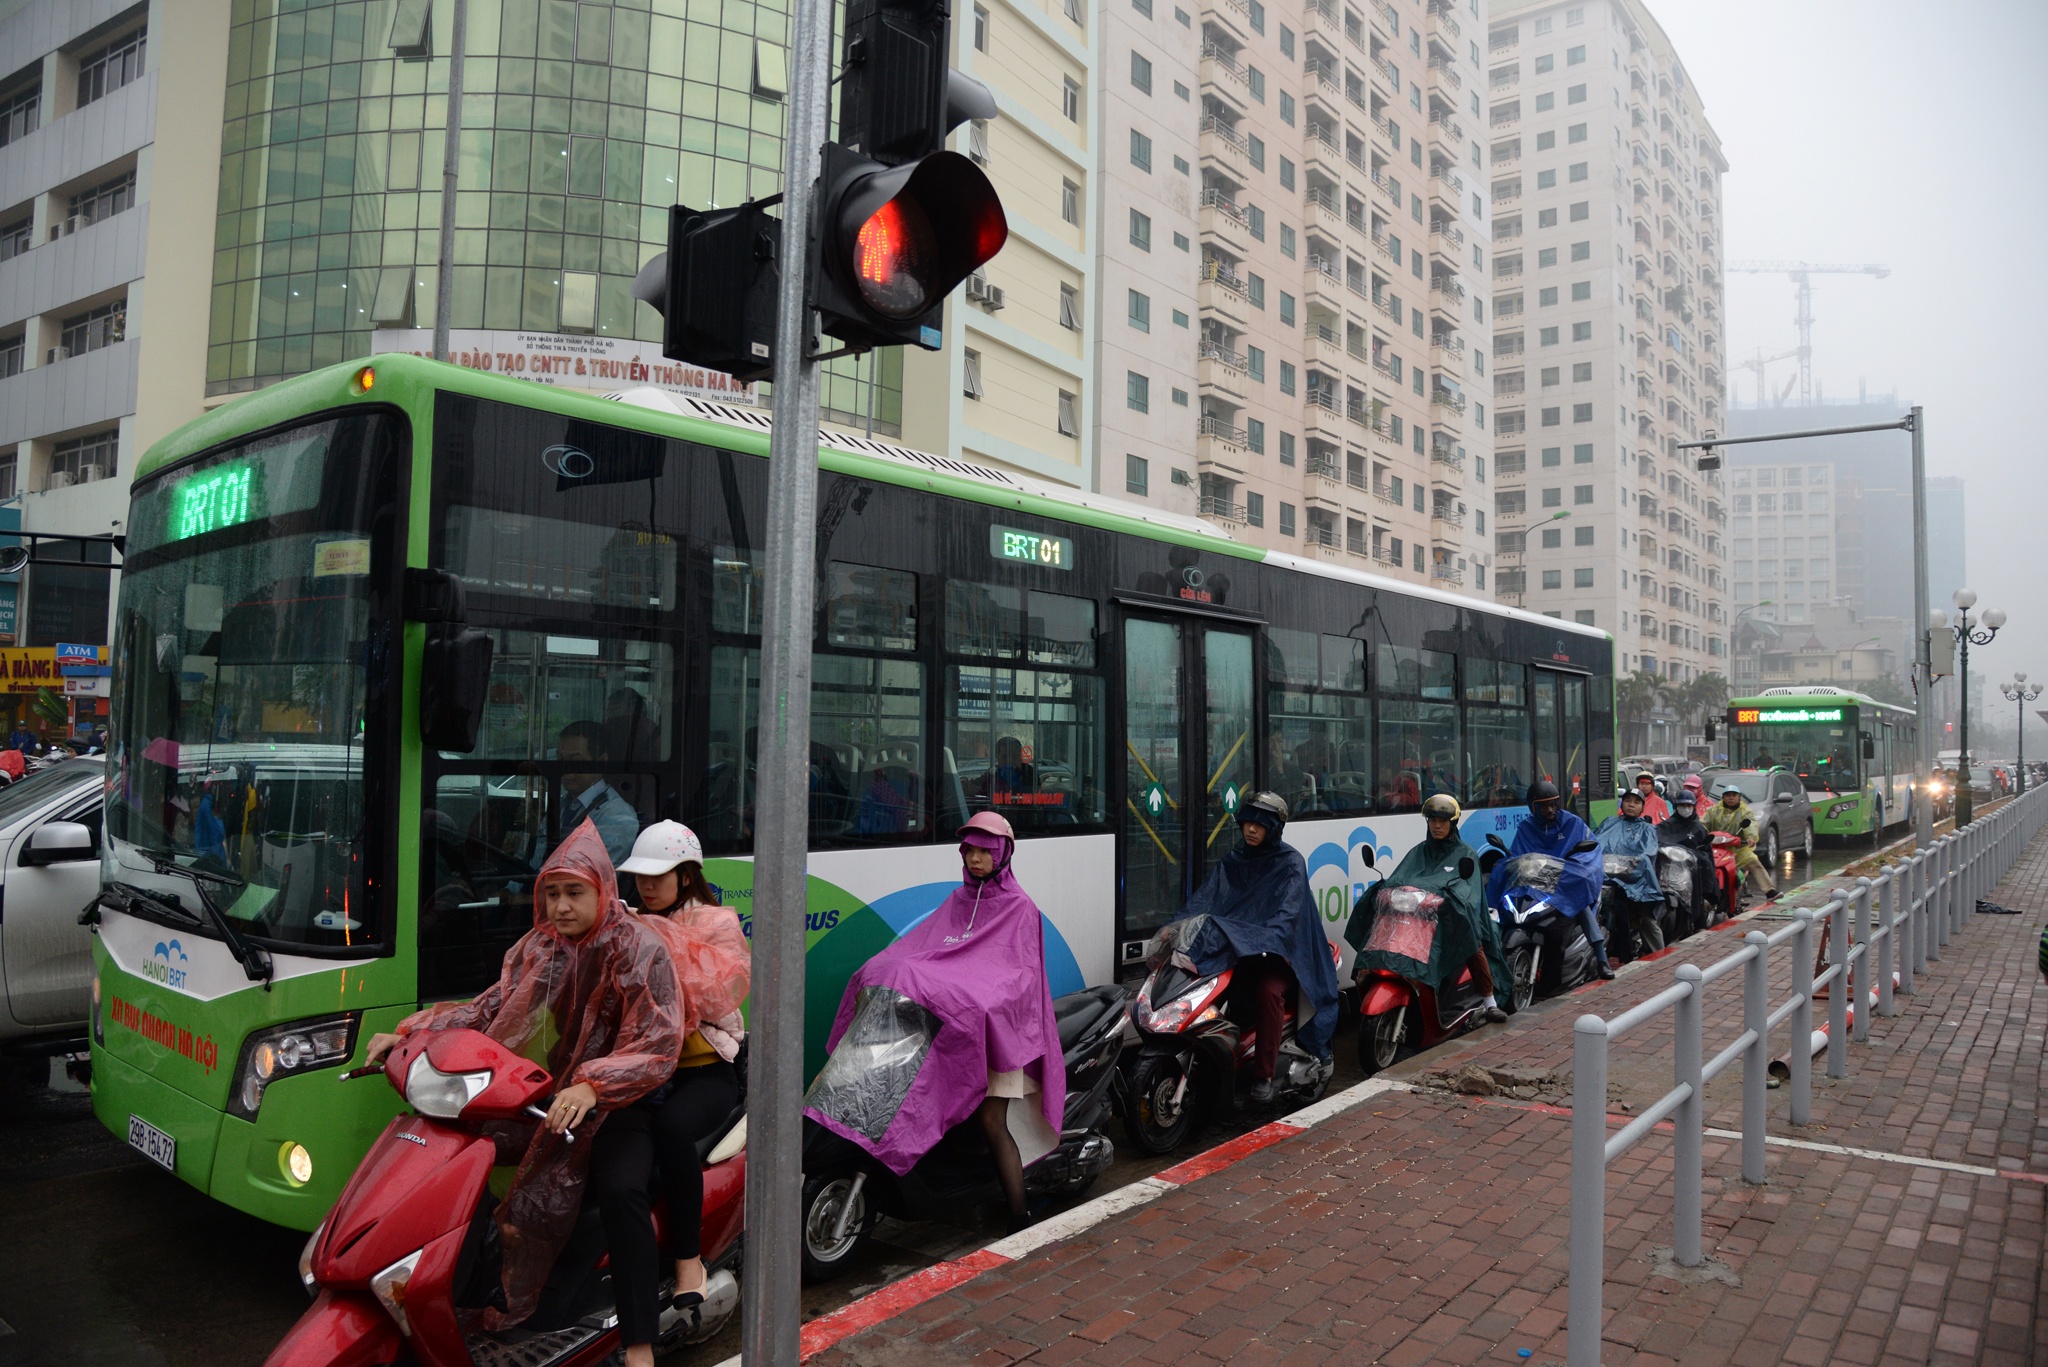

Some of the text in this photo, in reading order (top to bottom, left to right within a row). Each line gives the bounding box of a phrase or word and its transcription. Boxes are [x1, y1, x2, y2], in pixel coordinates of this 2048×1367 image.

[461, 347, 492, 370] ĐÀO
[497, 353, 526, 376] TẠO
[530, 354, 571, 375] CNTT
[575, 357, 587, 376] &
[590, 355, 650, 382] TRUYỀN
[653, 362, 704, 389] THÔNG
[180, 467, 251, 540] BRT 01
[1004, 532, 1060, 565] BRT 01
[12, 652, 51, 679] HÀNG
[65, 645, 91, 656] ATM
[1738, 710, 1759, 723] BRT
[123, 1001, 140, 1033] BUS
[141, 1010, 176, 1052] NHANH
[178, 1024, 193, 1060] HÀ
[194, 1033, 218, 1077] NỘI
[395, 1132, 427, 1147] HONDA
